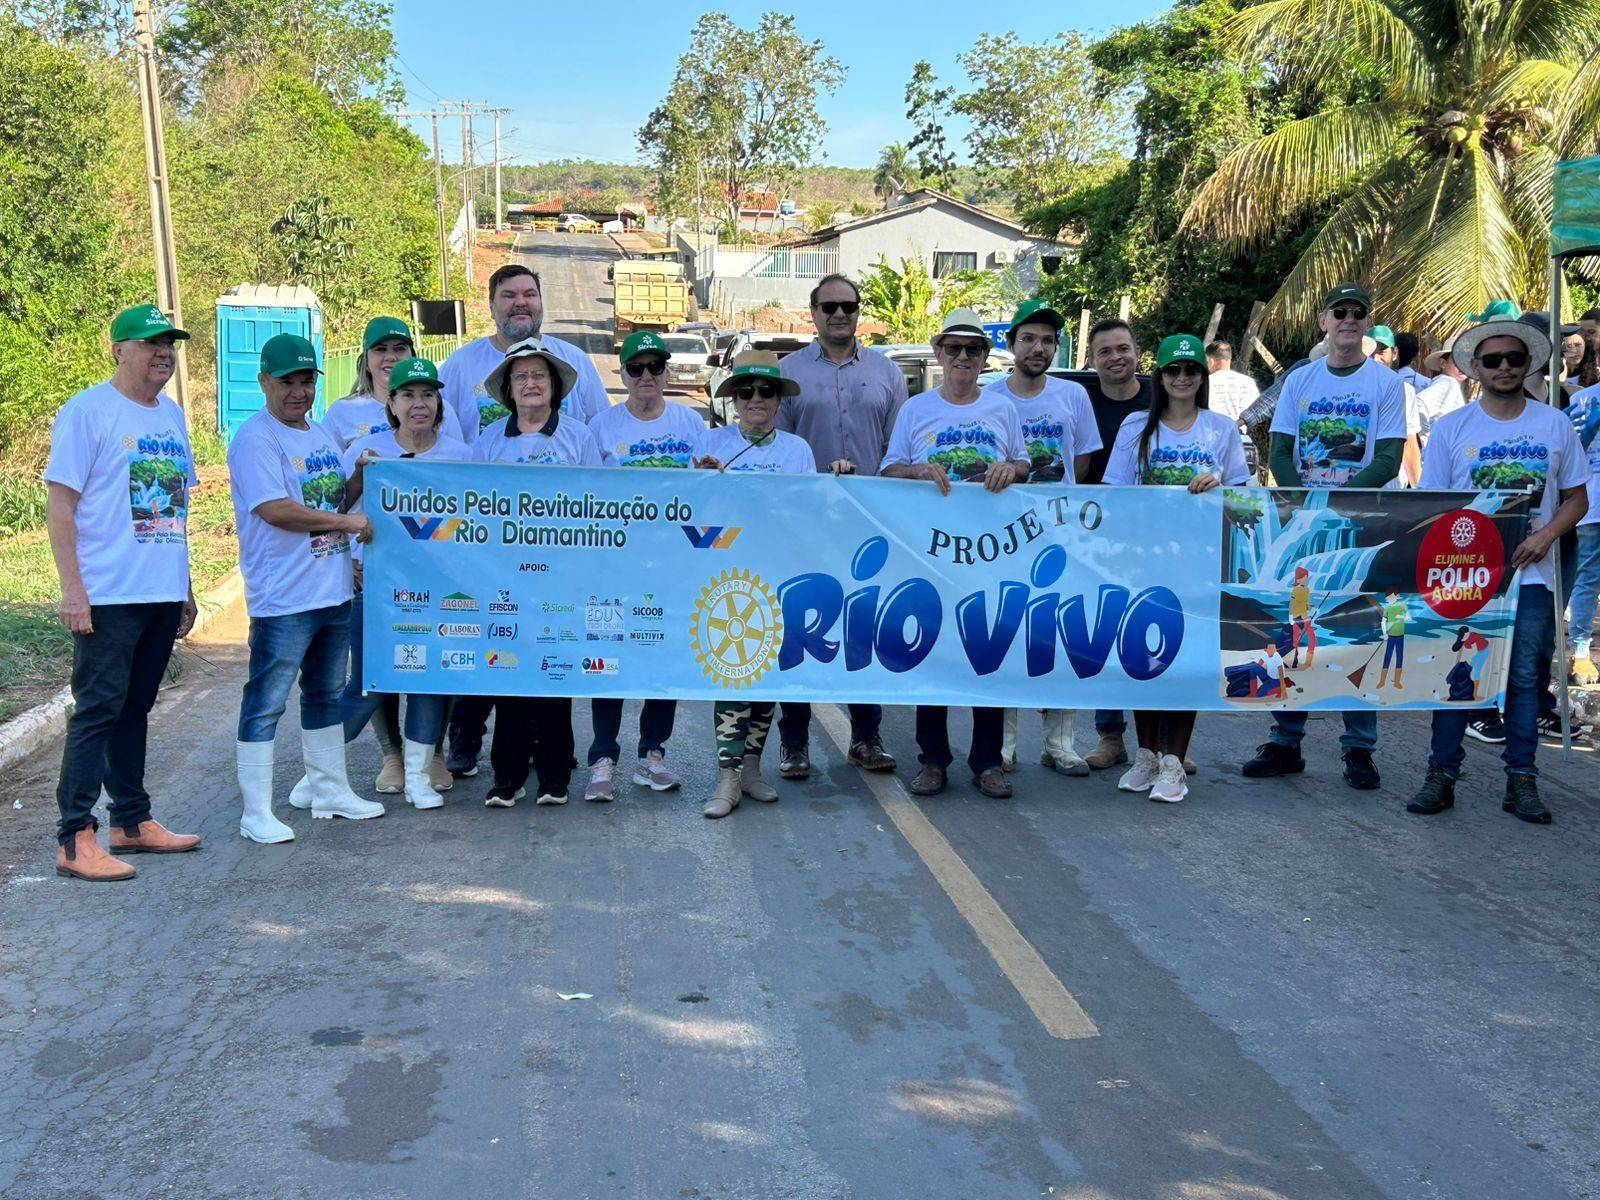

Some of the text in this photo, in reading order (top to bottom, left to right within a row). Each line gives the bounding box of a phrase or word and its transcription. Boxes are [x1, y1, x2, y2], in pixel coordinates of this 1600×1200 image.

[381, 487, 692, 526] Unidos Pela Revitalização do
[455, 518, 626, 548] Rio Diamantino
[927, 496, 1102, 565] PROJETO
[1435, 554, 1485, 564] ELIMINE A
[519, 562, 549, 572] APOIO:
[1426, 564, 1490, 589] PÓLIO
[708, 581, 747, 605] ROTARY
[1432, 586, 1483, 601] AGORA
[489, 602, 518, 612] EFISCON
[632, 606, 663, 617] SICOOB
[629, 632, 665, 640] MULTIVIX
[450, 653, 475, 665] CBH
[710, 632, 773, 677] INTERNATIONAL
